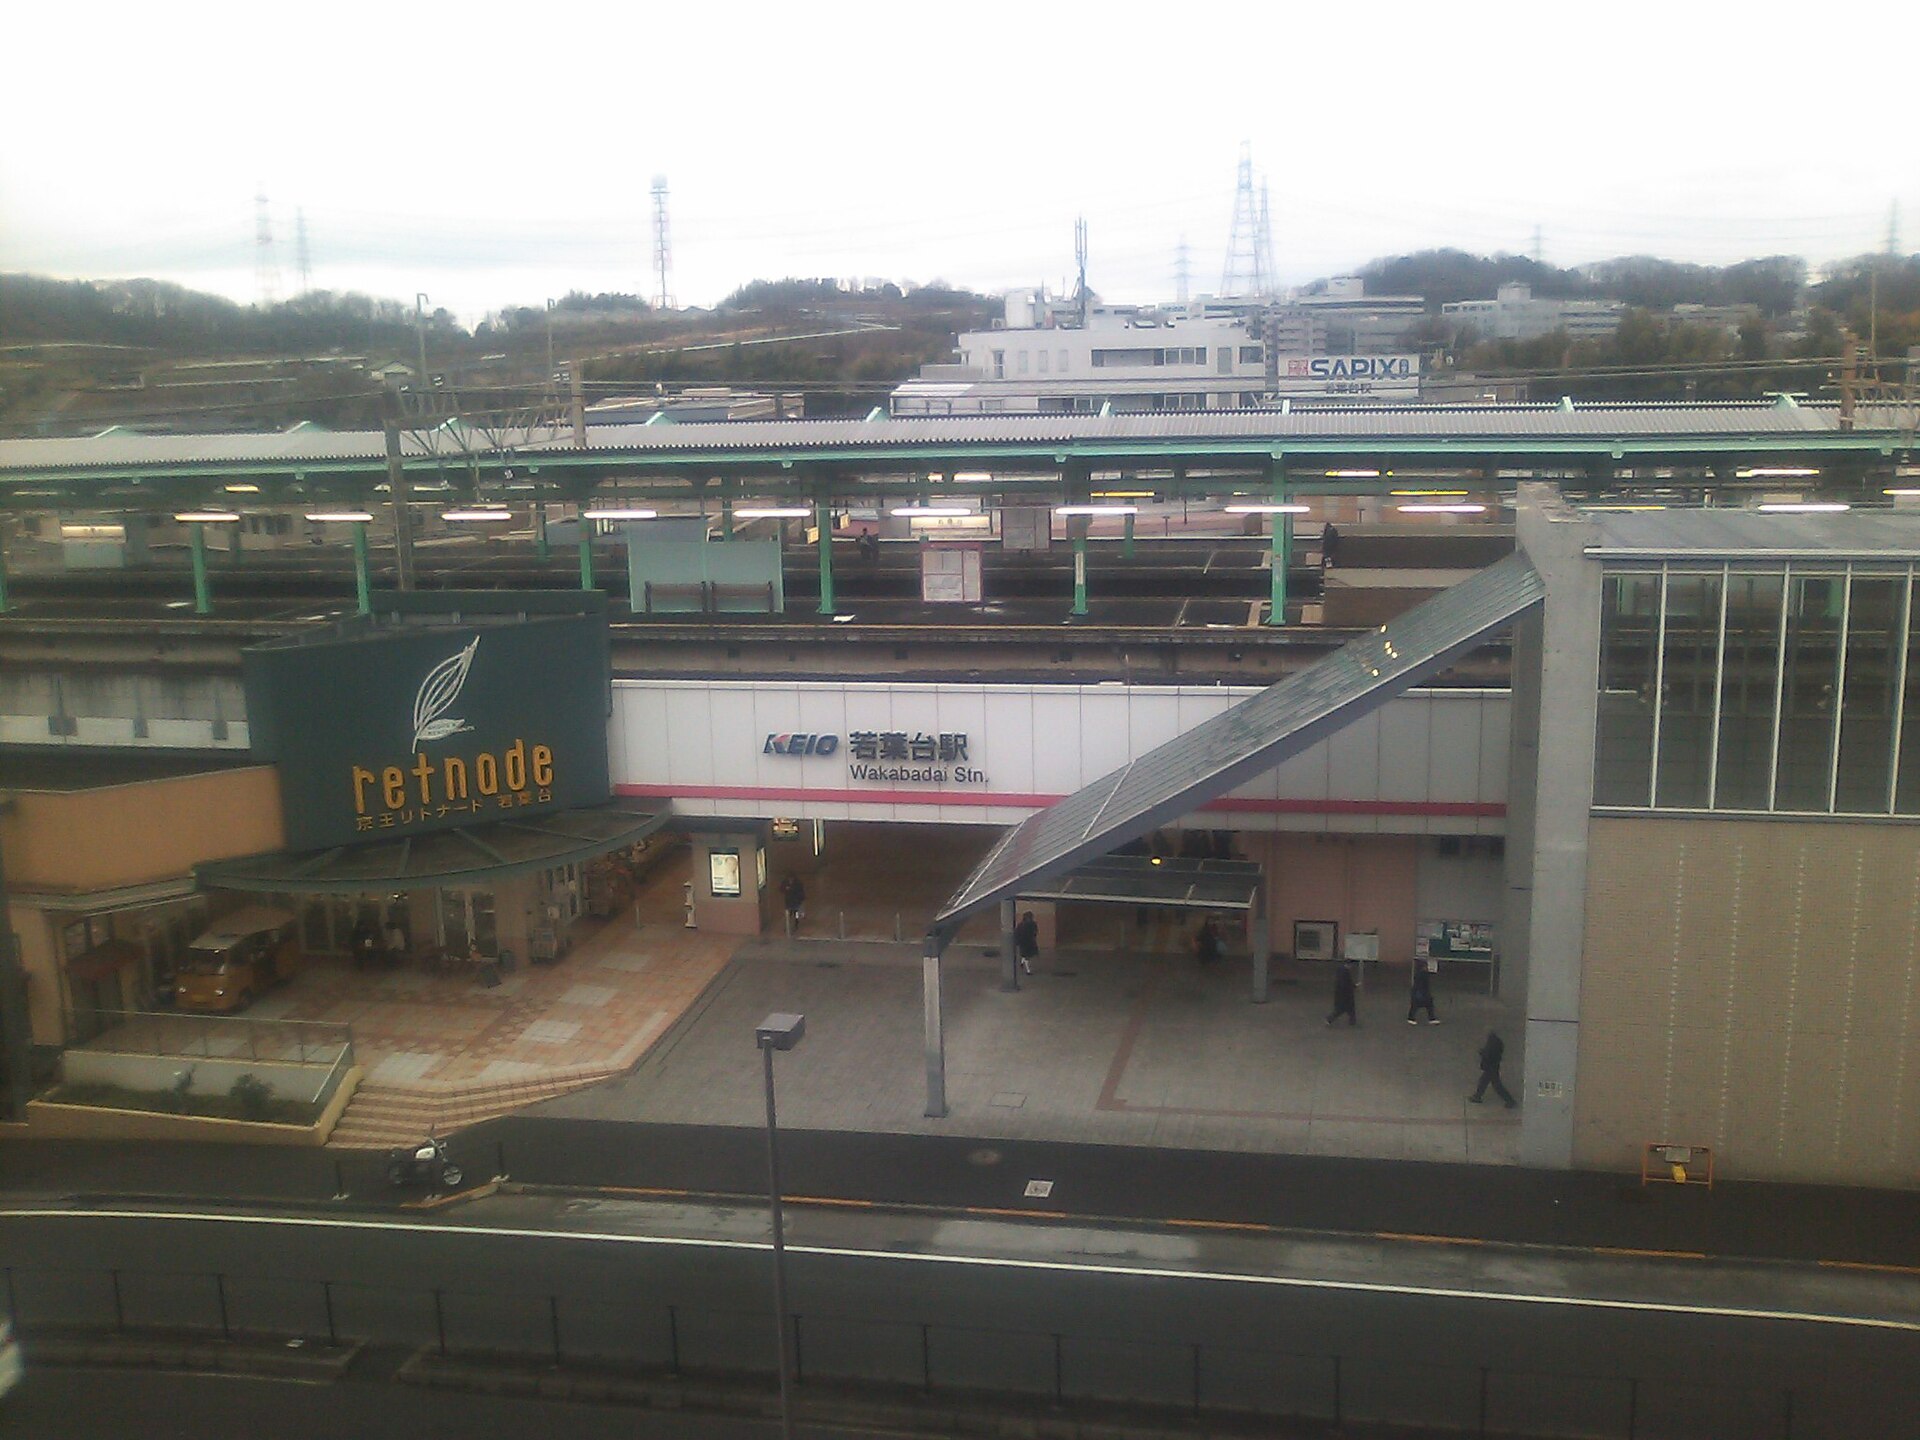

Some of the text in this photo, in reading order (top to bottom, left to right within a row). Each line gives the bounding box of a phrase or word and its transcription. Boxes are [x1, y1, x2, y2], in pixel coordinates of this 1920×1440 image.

[1310, 358, 1397, 380] SAPIX
[762, 733, 839, 756] KEIO
[849, 731, 969, 762] 若葉台駅
[849, 764, 990, 783] Wakabadai Stn.
[355, 799, 484, 832] 京王リトナード
